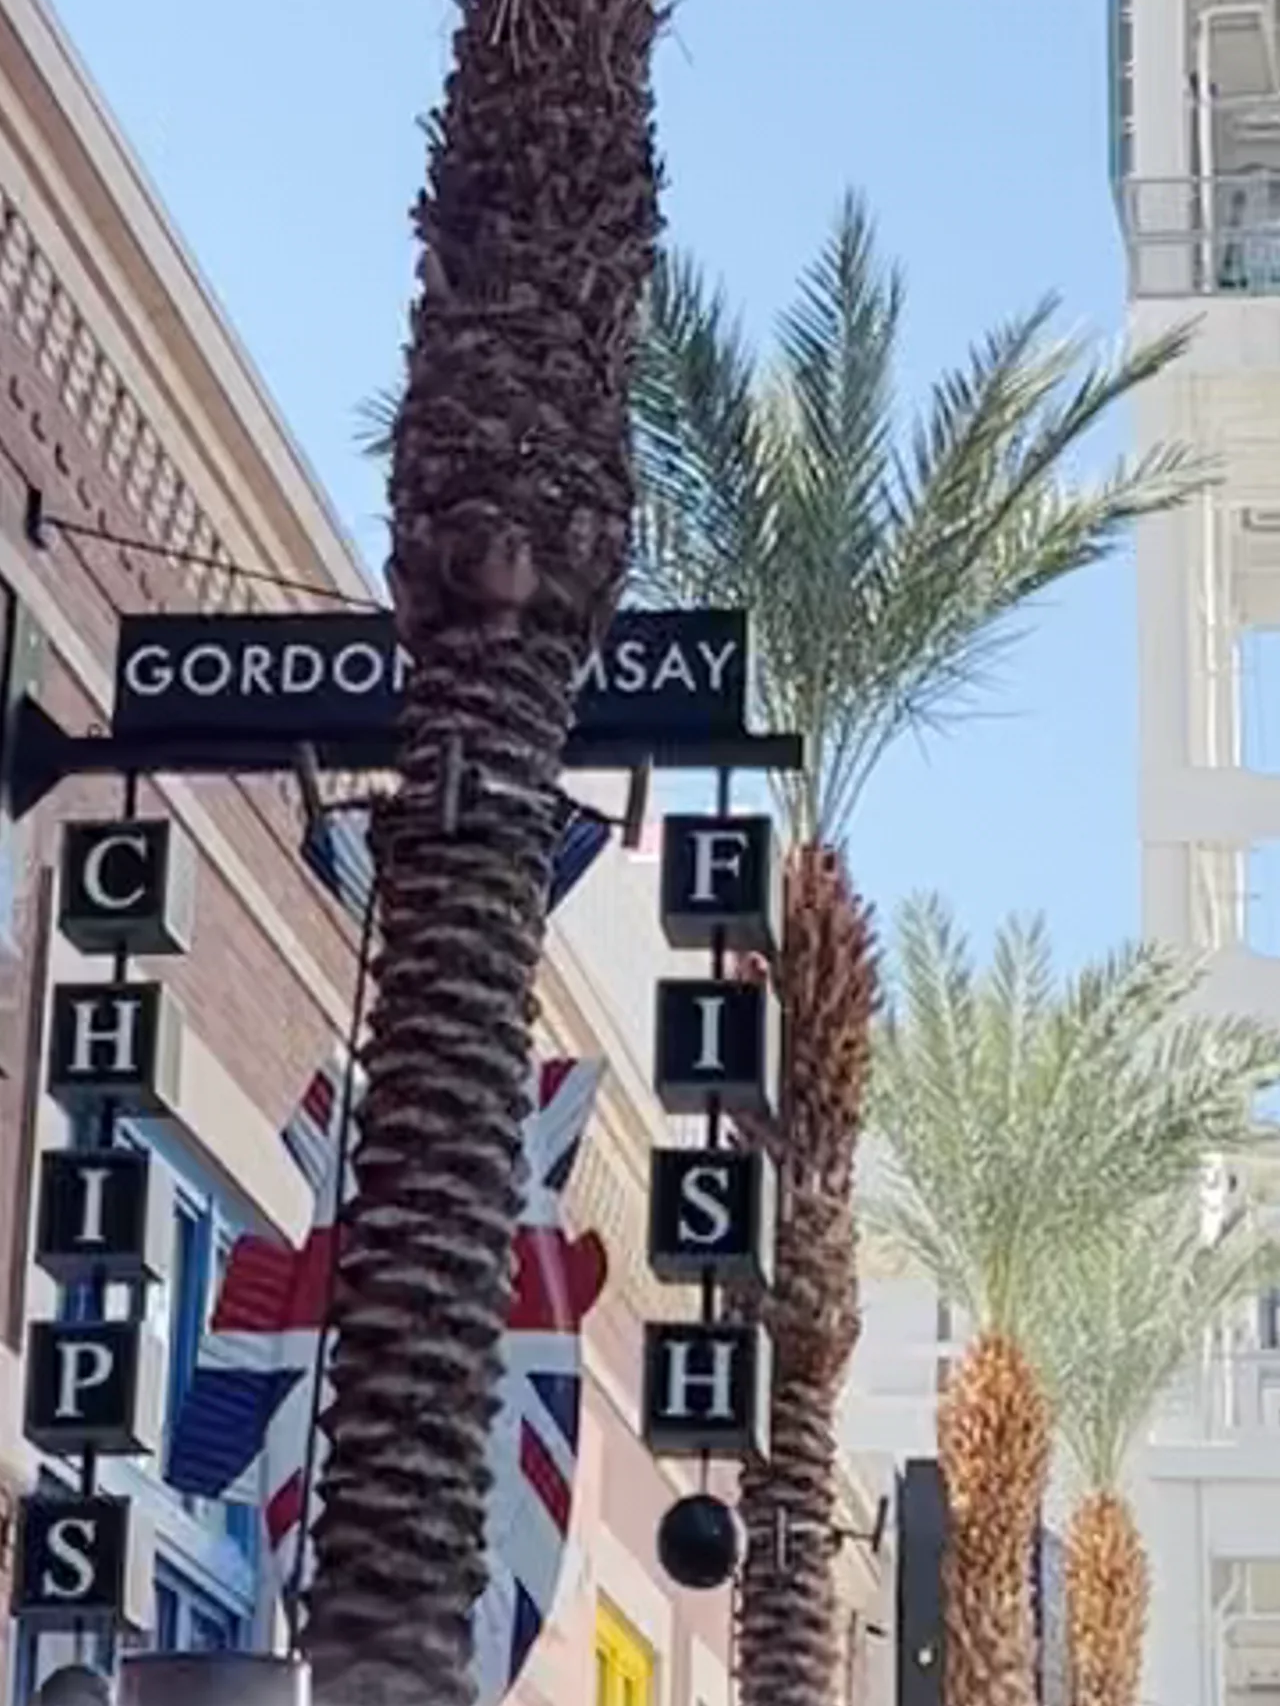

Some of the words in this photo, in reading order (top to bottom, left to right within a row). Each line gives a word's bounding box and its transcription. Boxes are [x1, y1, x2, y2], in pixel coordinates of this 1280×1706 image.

[566, 641, 736, 692] MSAY
[42, 837, 147, 1598] CHIPS
[662, 831, 748, 1419] FISH
